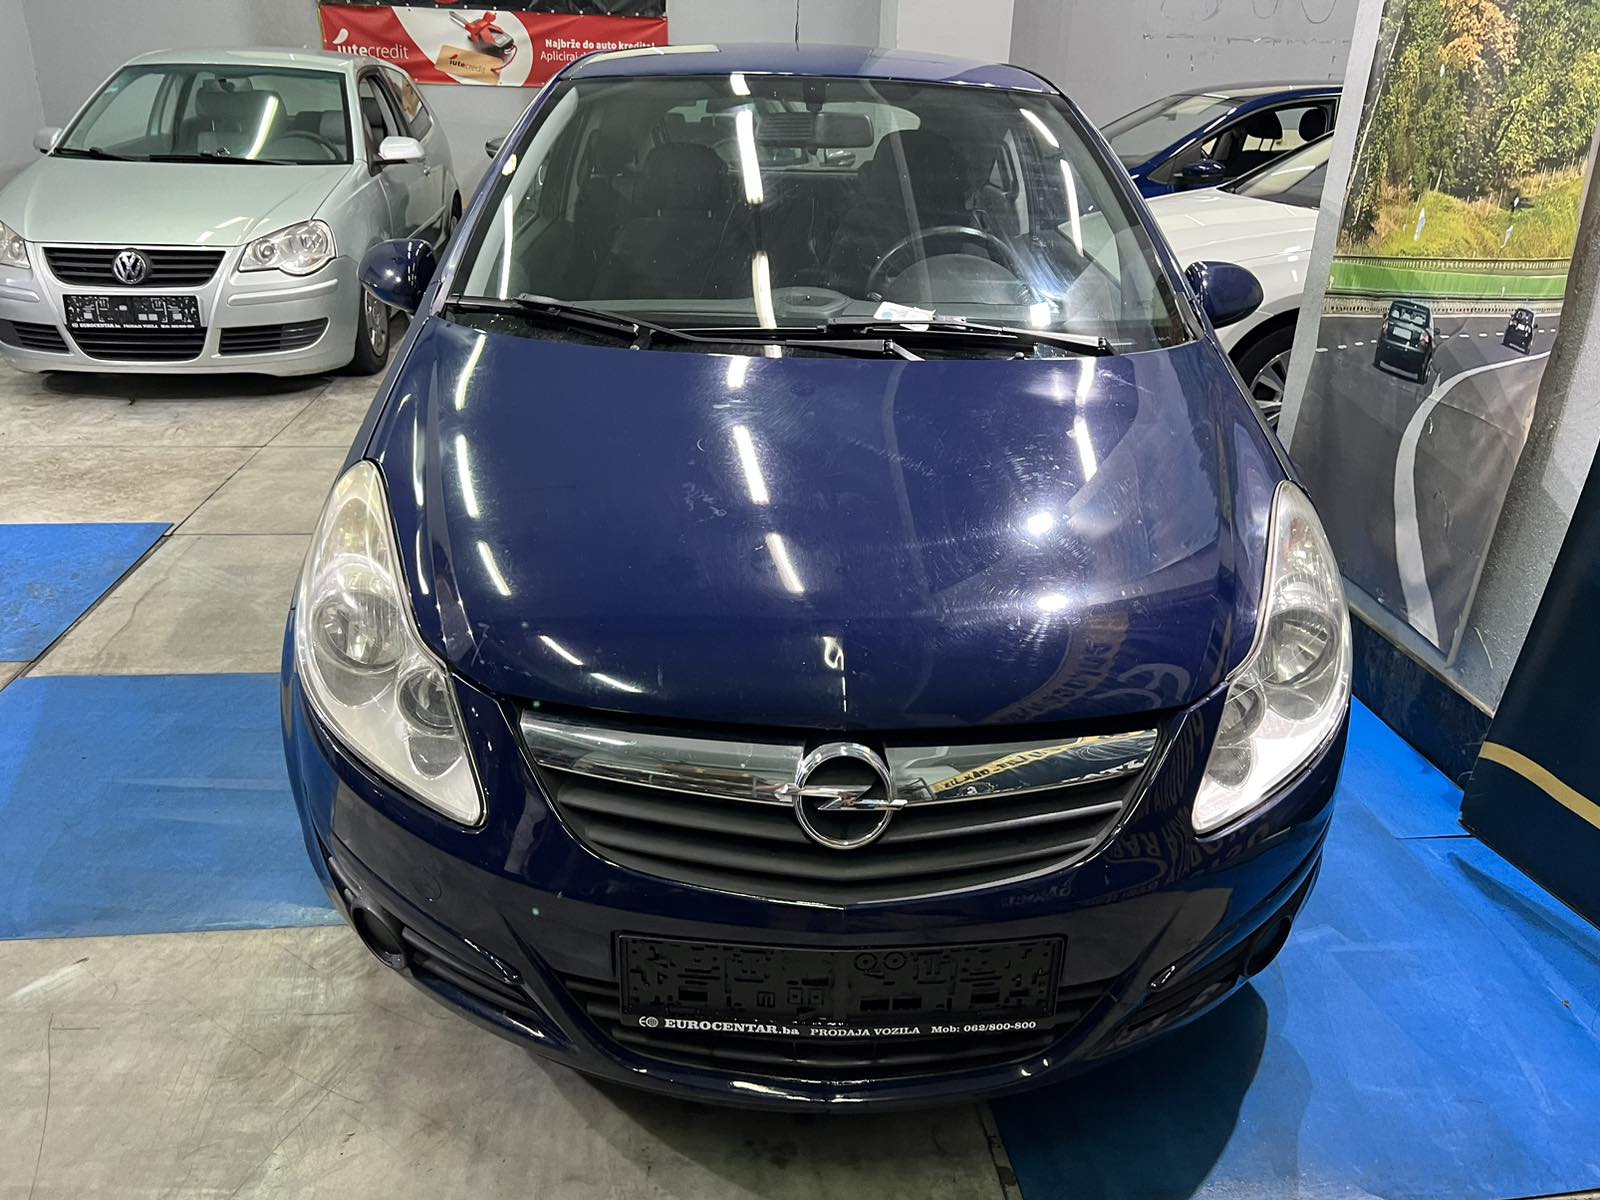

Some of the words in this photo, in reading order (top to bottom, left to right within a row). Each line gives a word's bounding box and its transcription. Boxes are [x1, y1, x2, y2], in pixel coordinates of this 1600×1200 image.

[333, 28, 409, 60] iutecredit
[545, 38, 581, 50] Najbrže
[582, 40, 595, 49] do
[596, 41, 617, 50] auto
[664, 1018, 800, 1036] EUROCENTAR.ba
[810, 1027, 871, 1037] PRODAJA
[873, 1026, 921, 1036] VOZILA
[931, 1025, 960, 1033] Mob:
[963, 1021, 1037, 1032] 062/800-800
